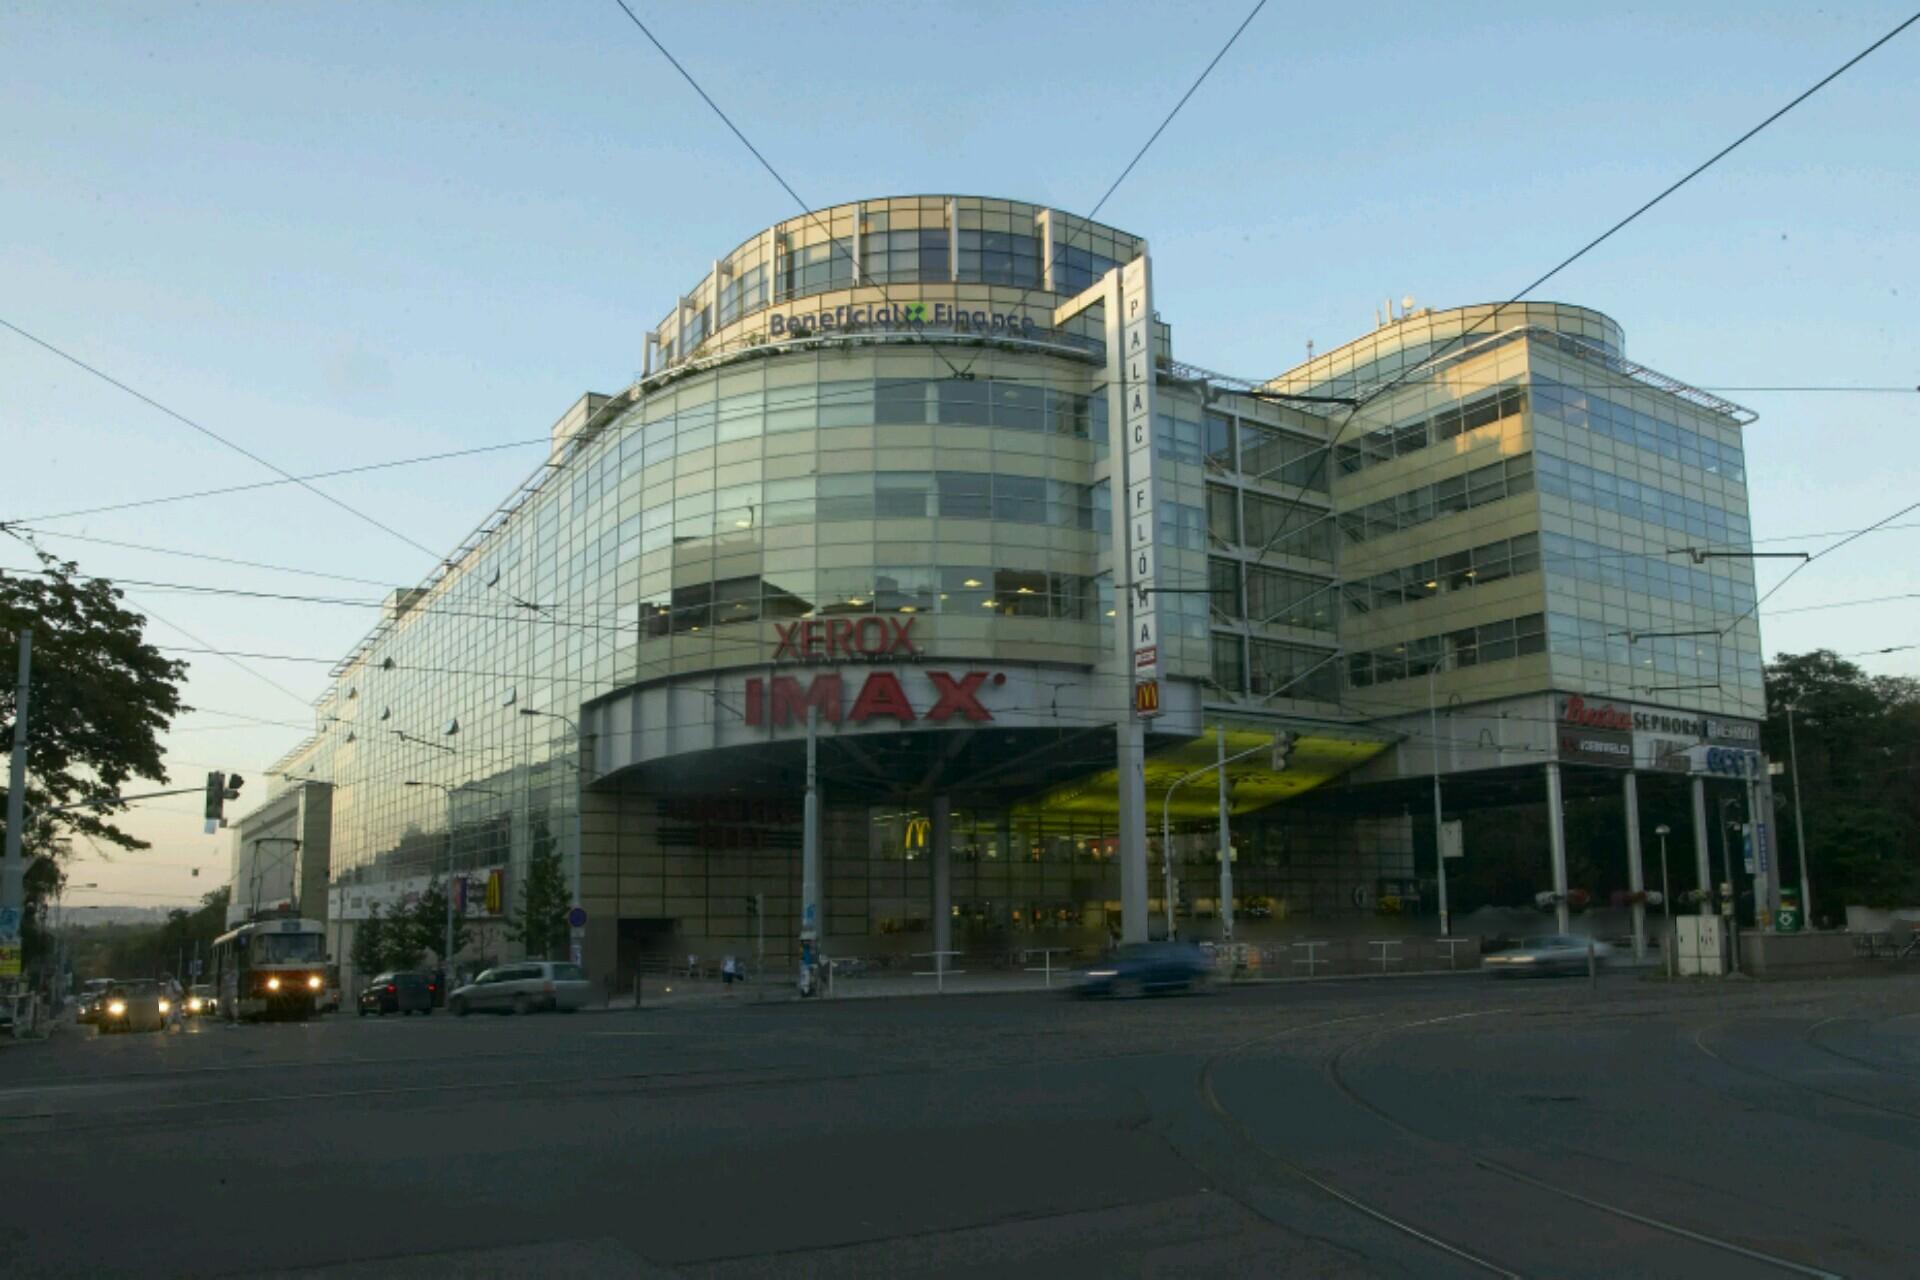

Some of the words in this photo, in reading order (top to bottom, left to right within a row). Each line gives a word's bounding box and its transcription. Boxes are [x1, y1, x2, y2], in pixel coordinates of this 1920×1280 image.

[770, 302, 899, 337] Beneficial
[934, 303, 1036, 338] Finance
[773, 616, 918, 660] XEROX
[744, 671, 995, 728] IMAX
[1632, 711, 1699, 736] SEPHORA
